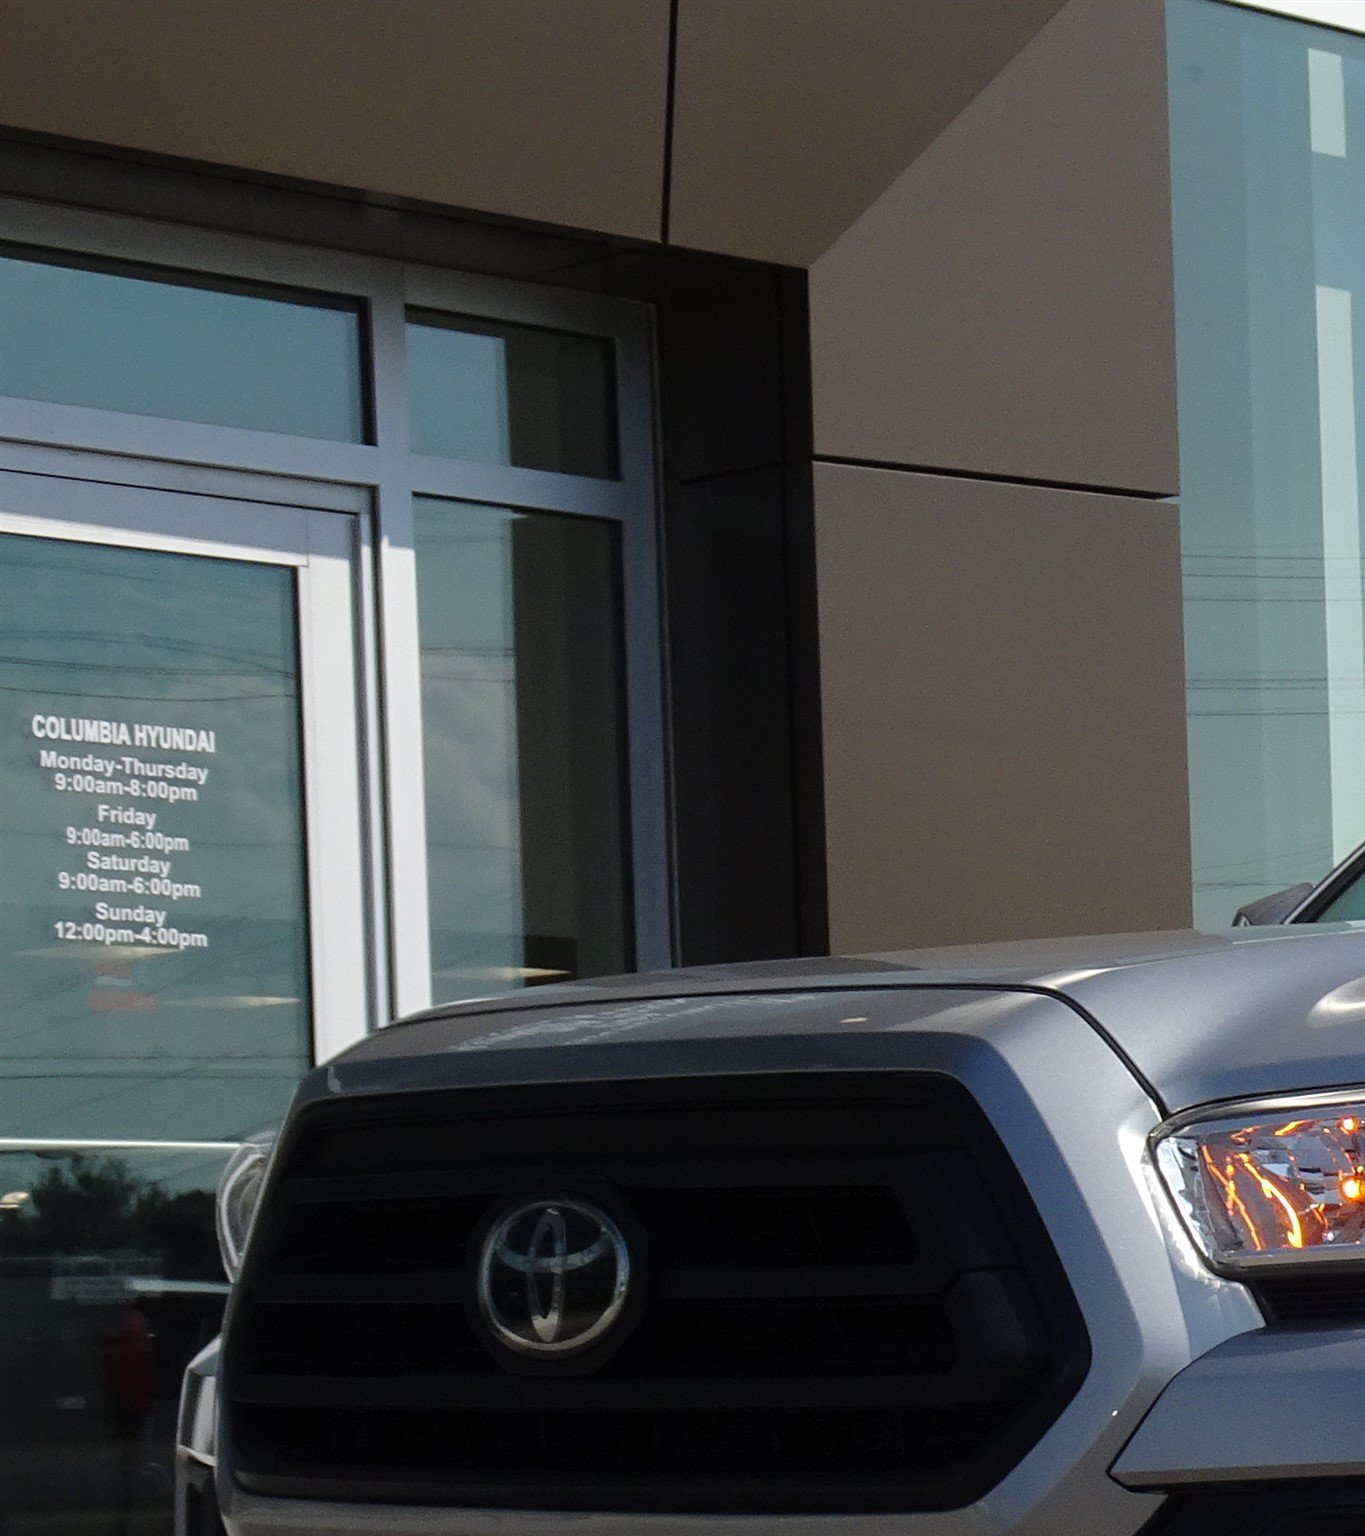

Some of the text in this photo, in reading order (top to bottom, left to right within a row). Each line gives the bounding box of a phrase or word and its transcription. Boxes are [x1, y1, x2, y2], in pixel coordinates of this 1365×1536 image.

[32, 715, 216, 753] COLUMBIA HYUNDAI
[40, 750, 208, 784] Monday-Thursday
[54, 773, 198, 803] 9:00am-8:00pm
[98, 804, 157, 830] Friday
[66, 827, 189, 854] 9:00am-6:00pm
[87, 851, 171, 877] Saturday
[57, 871, 201, 900] 9:00am-6:00pm
[95, 902, 166, 926] Sunday
[54, 921, 208, 949] 12:00pm-4:00pm
